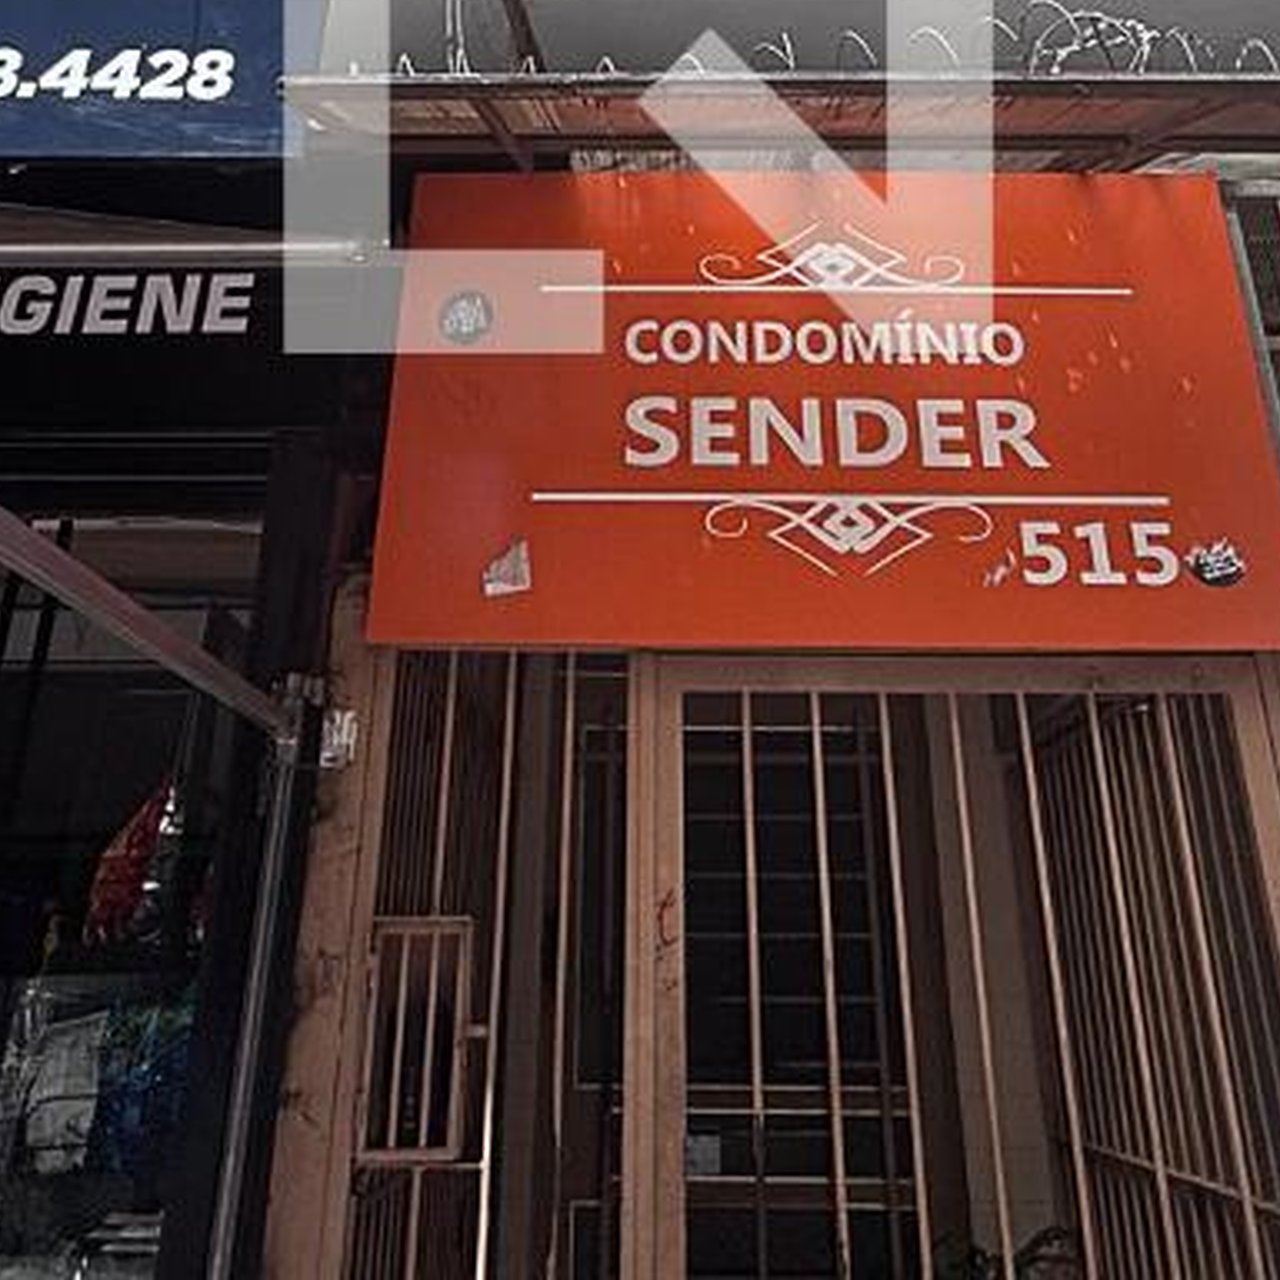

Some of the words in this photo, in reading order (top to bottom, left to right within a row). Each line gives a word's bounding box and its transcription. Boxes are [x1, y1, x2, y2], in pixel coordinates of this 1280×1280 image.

[624, 308, 1026, 367] CONDOMÍNIO
[624, 395, 1052, 470] SENDER
[1018, 521, 1181, 587] 515
